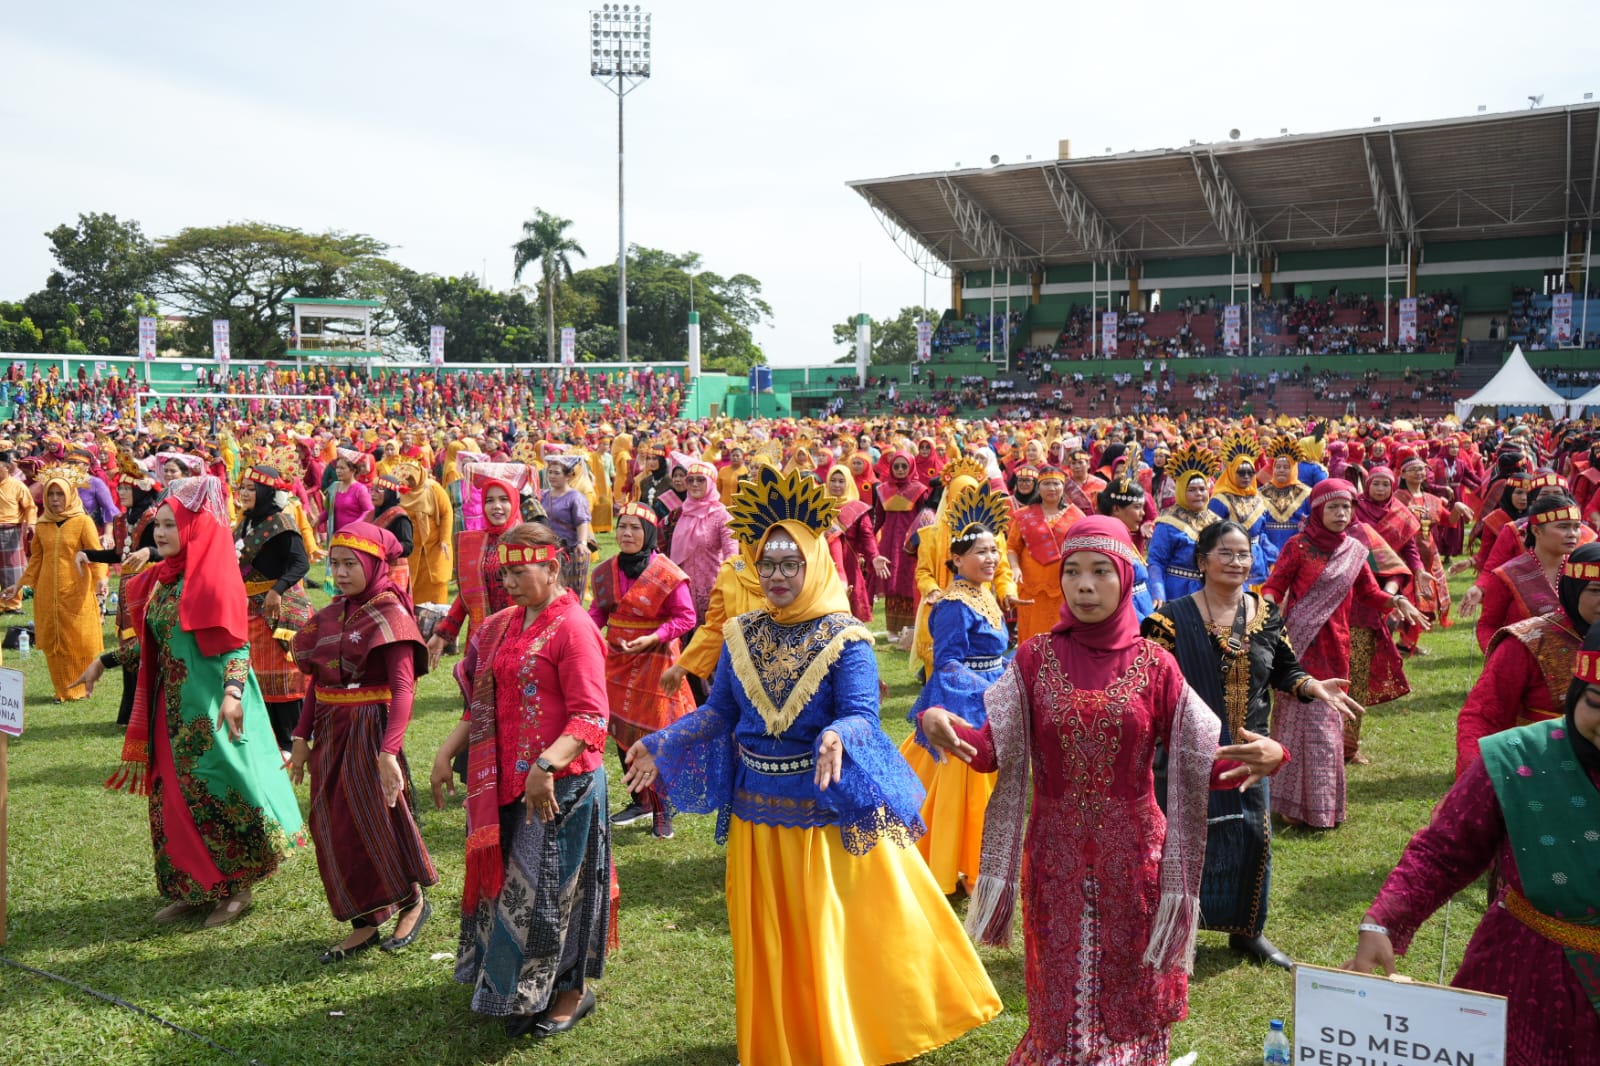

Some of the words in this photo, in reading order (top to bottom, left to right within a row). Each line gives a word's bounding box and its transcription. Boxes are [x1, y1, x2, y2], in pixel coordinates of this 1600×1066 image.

[0, 695, 19, 709] DAN
[0, 709, 16, 722] NIA
[1383, 1013, 1409, 1033] 13
[1320, 1026, 1357, 1047] SD
[1368, 1034, 1475, 1066] MEDAN
